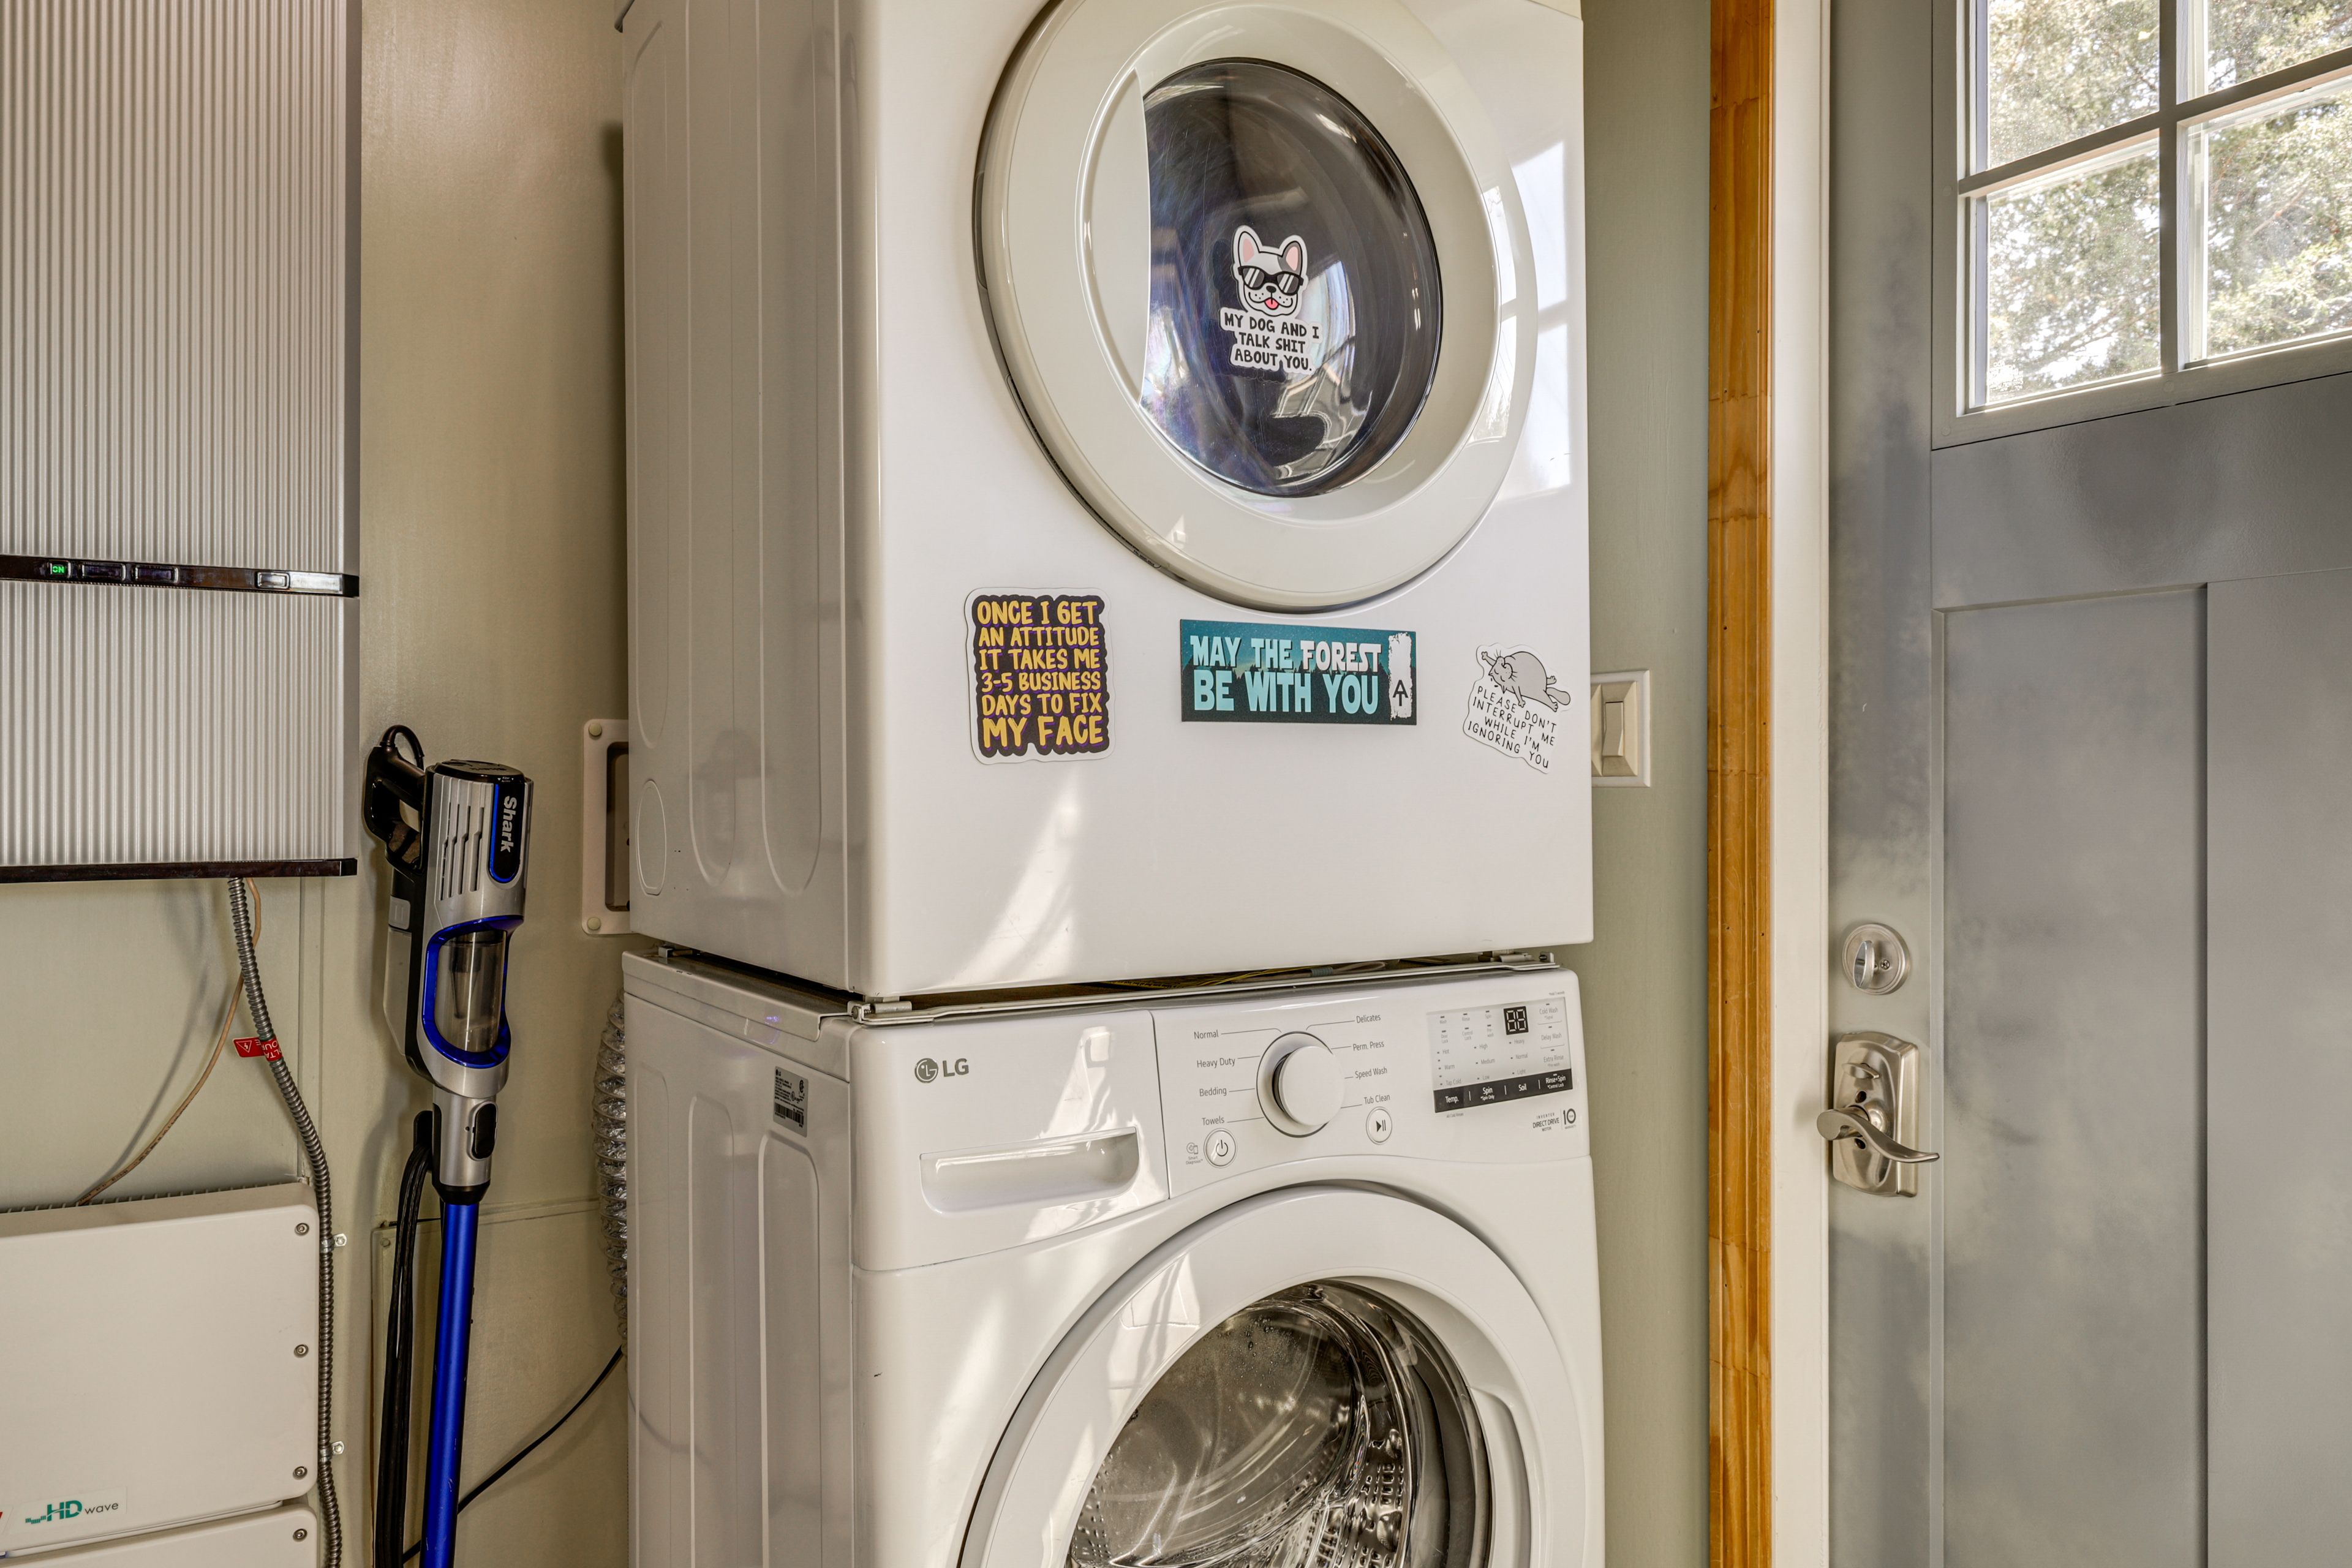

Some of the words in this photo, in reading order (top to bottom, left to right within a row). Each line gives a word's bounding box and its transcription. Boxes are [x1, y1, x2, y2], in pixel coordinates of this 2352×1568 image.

[1224, 313, 1243, 328] MY
[1250, 317, 1275, 333] DOG
[1281, 322, 1306, 337] AND
[1313, 326, 1319, 339] I
[1239, 332, 1270, 349] TALK
[1276, 338, 1305, 353] SHIT
[1235, 349, 1278, 366] ABOUT
[1284, 355, 1312, 371] YOU.
[978, 601, 1033, 625] ONCE
[1041, 601, 1049, 624] I
[1057, 601, 1097, 624] GET
[979, 627, 1003, 647] AN
[1011, 627, 1099, 646] ATTITUDE
[980, 649, 1001, 670] IT
[1008, 649, 1067, 670] TAKES
[1074, 648, 1100, 669] ME
[1190, 635, 1241, 667] MAY
[1251, 638, 1293, 669] THE
[1300, 640, 1381, 672] FOREST
[981, 673, 1012, 692] 3-5
[1019, 671, 1101, 691] BUSINESS
[1194, 669, 1234, 711] BE
[1245, 671, 1311, 712] WITH
[1322, 674, 1378, 714] YOU
[982, 694, 1031, 715] DAYS
[1037, 693, 1062, 714] TO
[1069, 693, 1102, 713] FIX
[1478, 686, 1517, 713] PLEASE
[1525, 710, 1556, 733] DON'T
[1473, 696, 1534, 734] INTERRUPT
[1542, 733, 1555, 745] ME
[982, 717, 1027, 748] MY
[1038, 715, 1102, 746] FACE
[1485, 717, 1516, 739] WHILE
[1525, 736, 1539, 752] I'M
[1468, 721, 1520, 753] IGNORING
[1530, 751, 1548, 768] YOU
[500, 796, 517, 853] Shark
[1356, 1014, 1381, 1023] Delicates
[1194, 1030, 1218, 1039] Normal
[942, 1058, 969, 1077] LG
[1197, 1060, 1218, 1068] Heavy
[1219, 1057, 1235, 1066] Duty
[1355, 1069, 1372, 1079] Speed
[1199, 1087, 1227, 1097] Bedding
[1376, 1094, 1390, 1102] Clean
[1202, 1116, 1224, 1125] Towels
[1563, 1109, 1576, 1125] 10
[85, 1503, 119, 1514] wave
